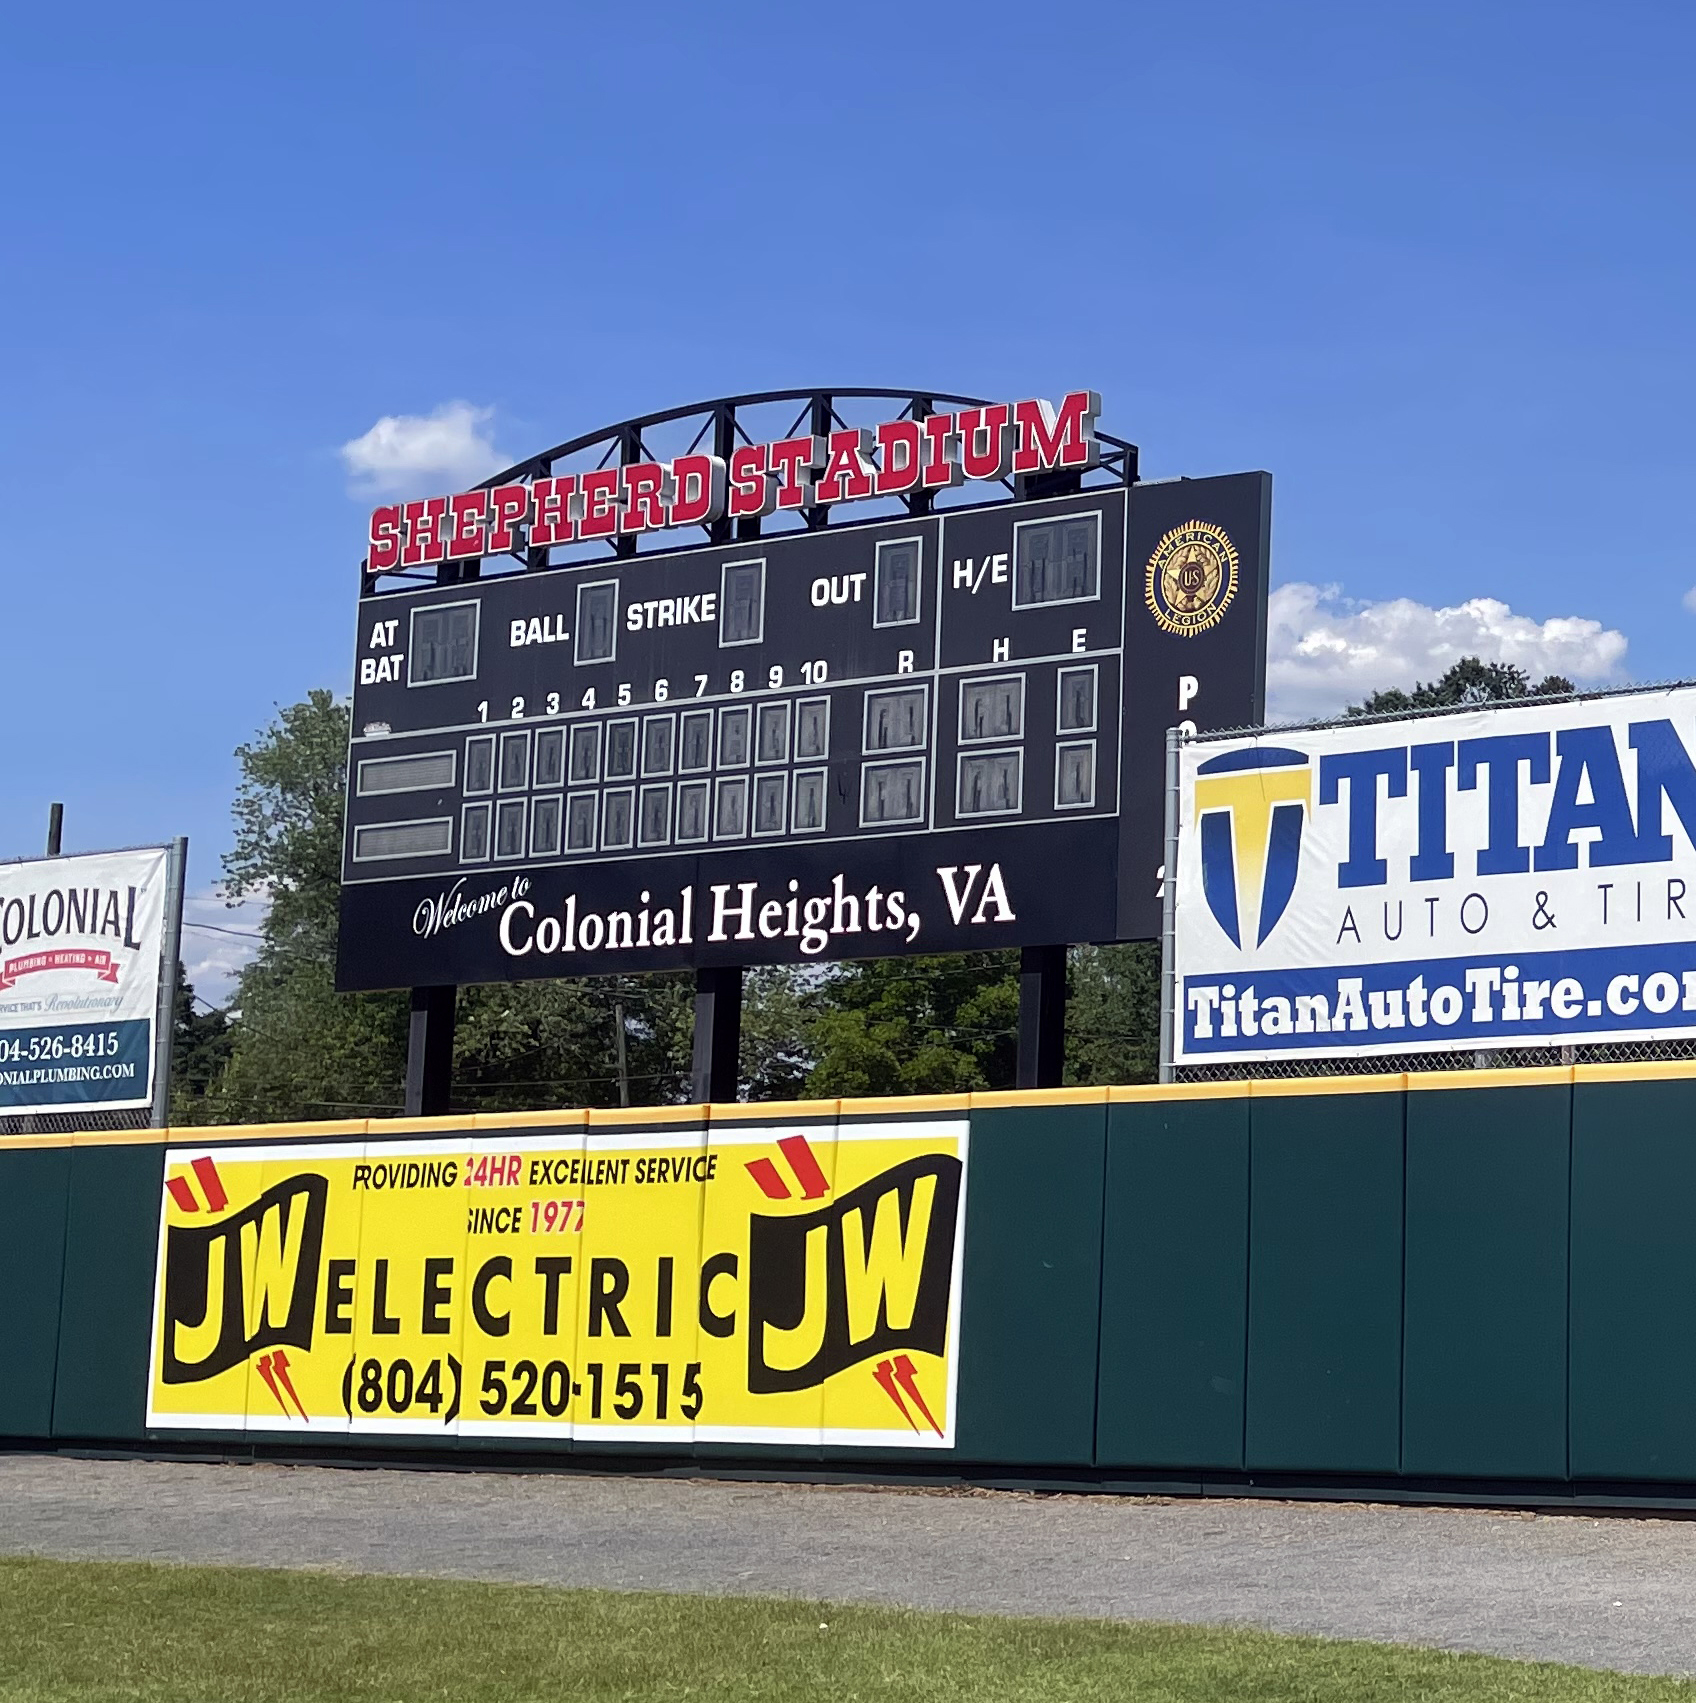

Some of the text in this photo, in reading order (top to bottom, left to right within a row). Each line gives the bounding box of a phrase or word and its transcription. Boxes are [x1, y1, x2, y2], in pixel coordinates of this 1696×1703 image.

[367, 390, 1096, 573] SHEPHERD STADIUM
[1158, 532, 1228, 569] AMERICAN
[810, 573, 866, 607] OUT
[953, 554, 1008, 594] H/E
[510, 614, 569, 648] BALL
[626, 593, 717, 631] STRIKE
[1165, 602, 1217, 625] LEGION
[369, 620, 399, 649] AT
[898, 629, 1087, 673] R H E
[360, 653, 404, 685] BAT
[477, 660, 828, 723] 1 2 3 4 5 6 7 8 9 10
[0, 885, 141, 955] OLONIAL
[413, 875, 532, 939] Welcome to
[499, 862, 1017, 956] Colonial Heights, VA
[1337, 893, 1489, 944] AUTO
[1532, 890, 1557, 930] &
[9, 953, 107, 973] PLUMBING HEATING AIR
[44, 993, 123, 1013] Revolutionary
[353, 1161, 458, 1190] PROVIDING
[529, 1158, 630, 1185] EXCELLENT
[635, 1154, 718, 1184] SERVICE
[531, 1200, 585, 1233] 1977
[174, 1173, 939, 1372] JW ELECTRIC JW
[342, 1353, 704, 1425] (804) 520-1515
